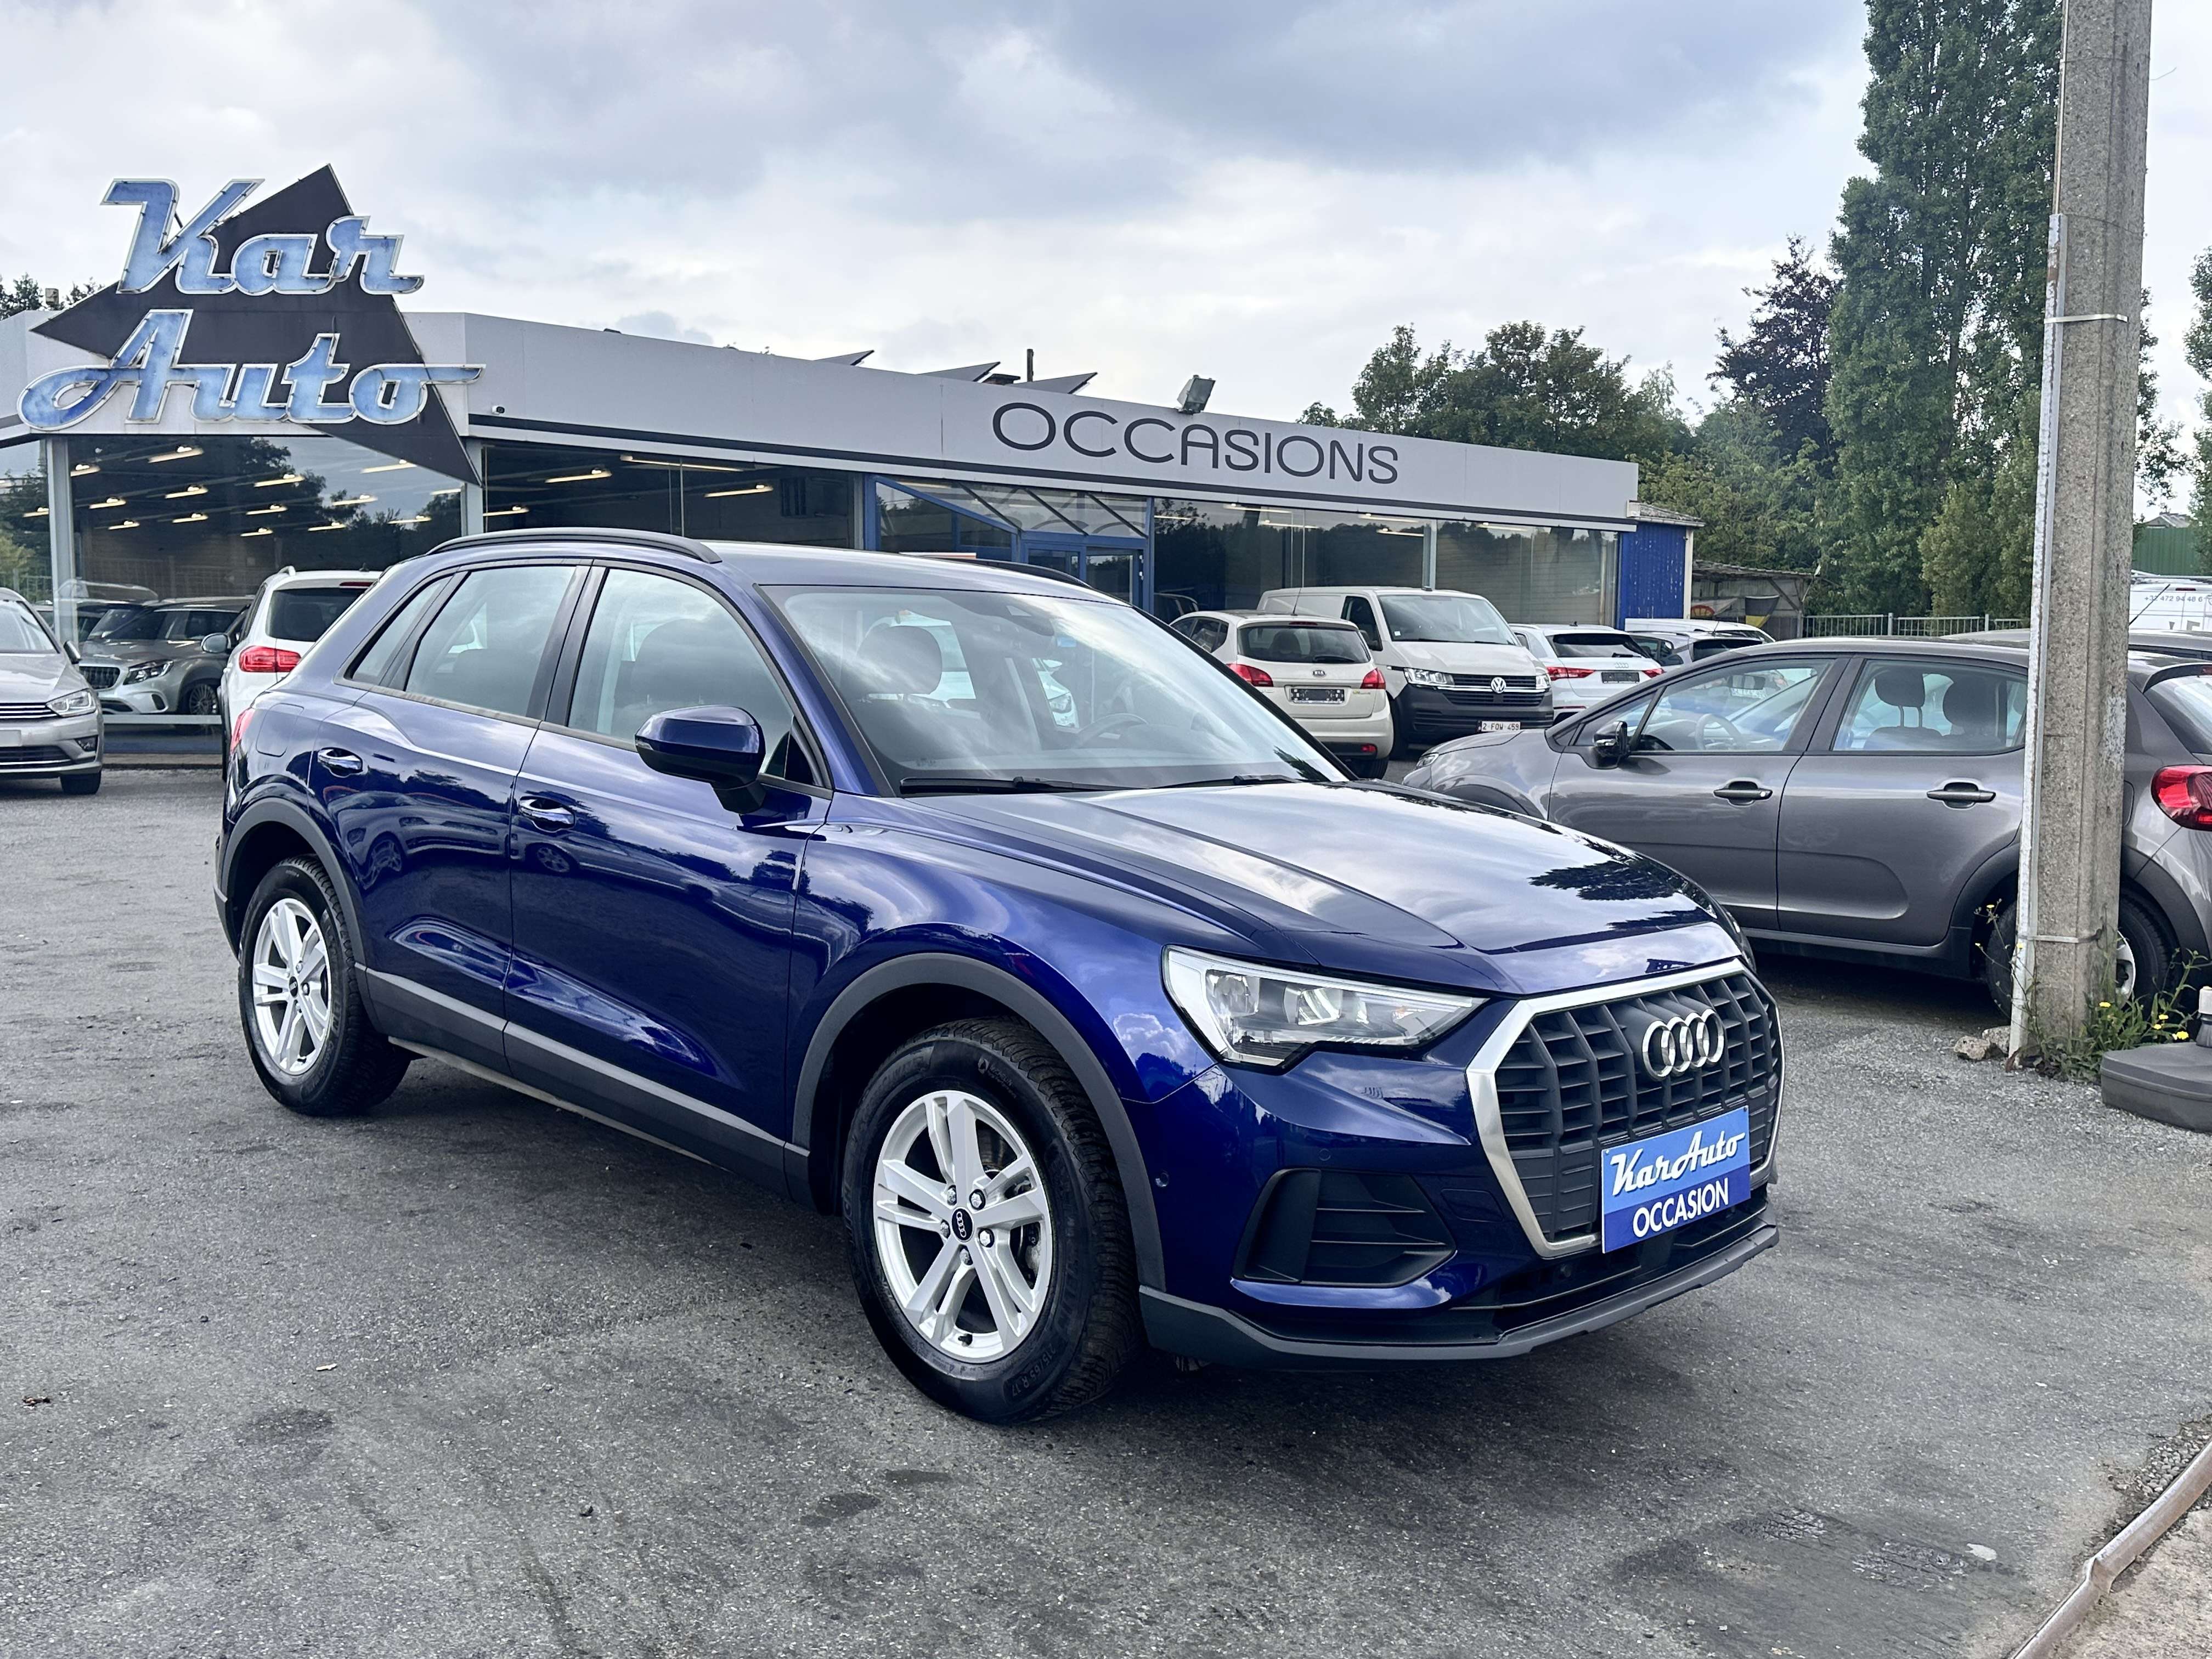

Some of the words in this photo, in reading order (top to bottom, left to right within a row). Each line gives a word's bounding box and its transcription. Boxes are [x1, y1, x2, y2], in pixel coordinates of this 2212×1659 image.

[100, 178, 424, 295] Kar
[17, 308, 487, 431] Auto
[992, 402, 1398, 484] OCCASIONS
[1632, 1178, 1729, 1238] OCCASION
